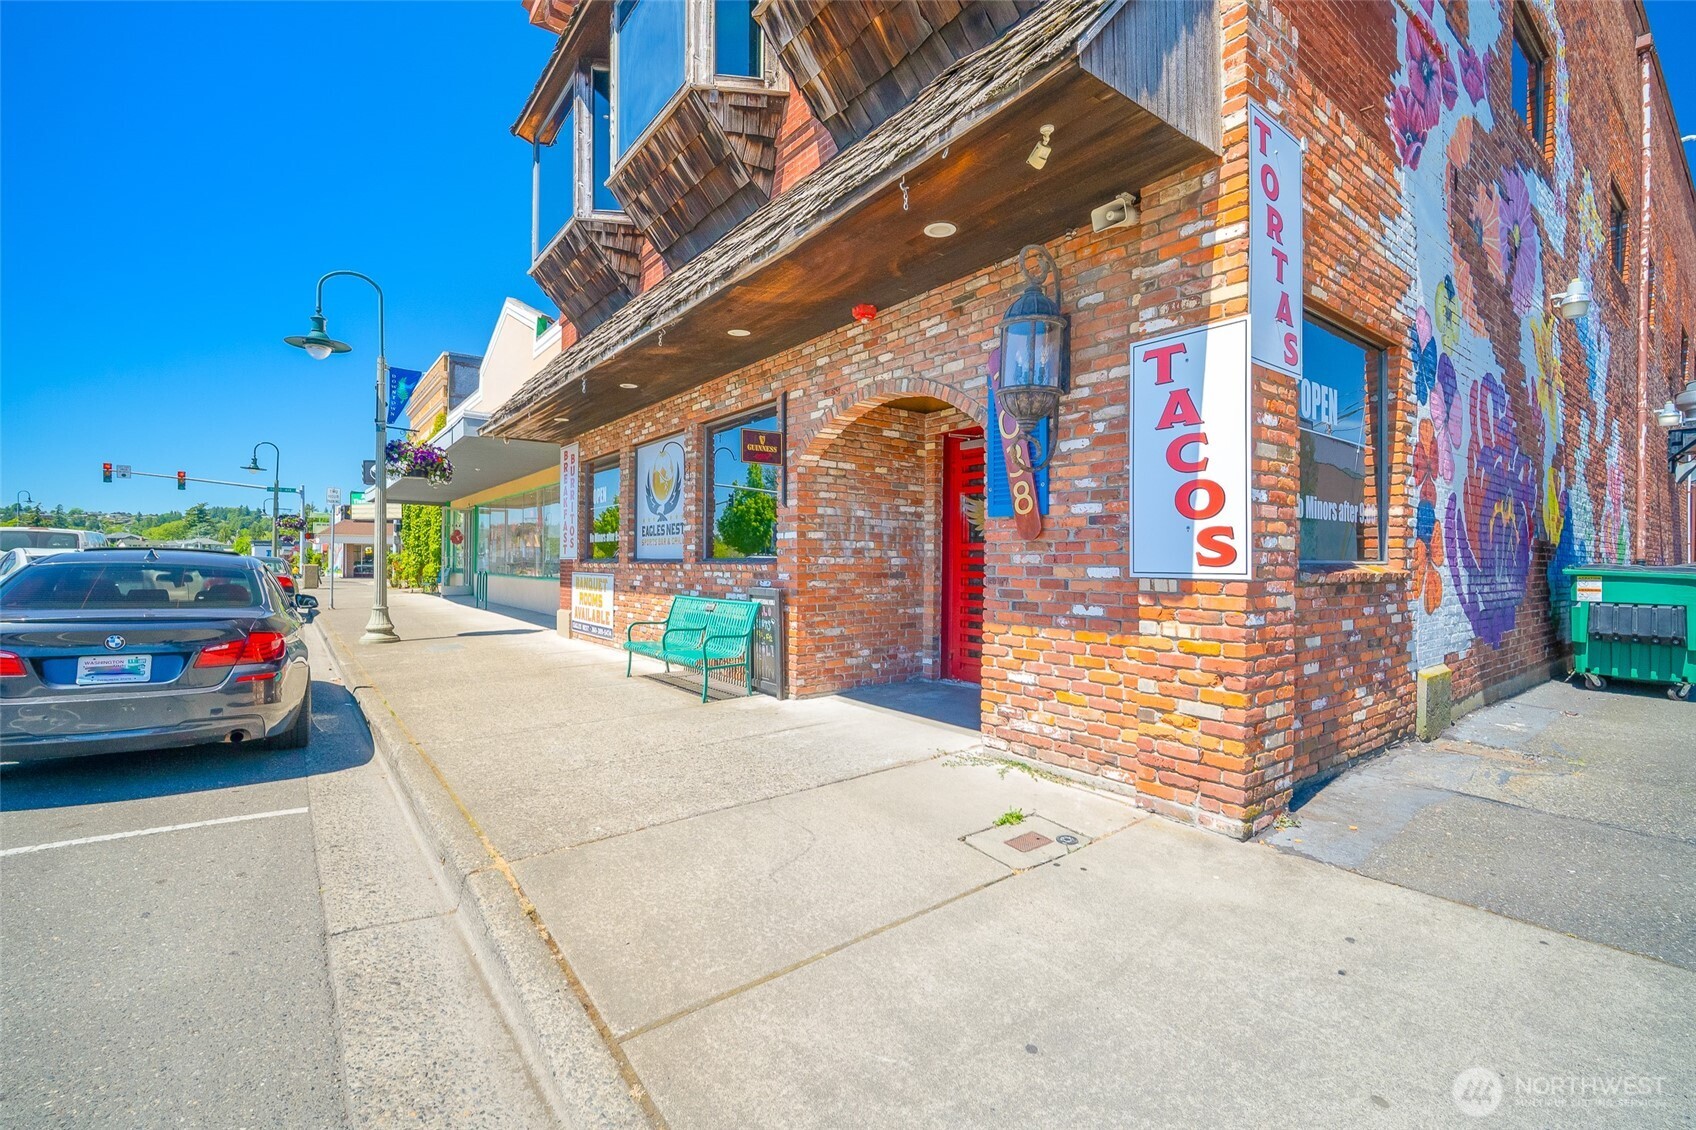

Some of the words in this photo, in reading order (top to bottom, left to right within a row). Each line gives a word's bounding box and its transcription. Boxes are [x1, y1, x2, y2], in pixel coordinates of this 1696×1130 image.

[1253, 115, 1299, 368] TORTAS
[1300, 377, 1338, 426] OPEN
[746, 443, 778, 453] GUINNESS
[1142, 342, 1238, 568] TACOS
[1305, 494, 1337, 522] Minors
[1338, 500, 1359, 523] after
[641, 524, 665, 537] EAGLES
[666, 522, 684, 535] NEST
[579, 592, 603, 608] ROOMS
[574, 606, 610, 626] AVAILABLE
